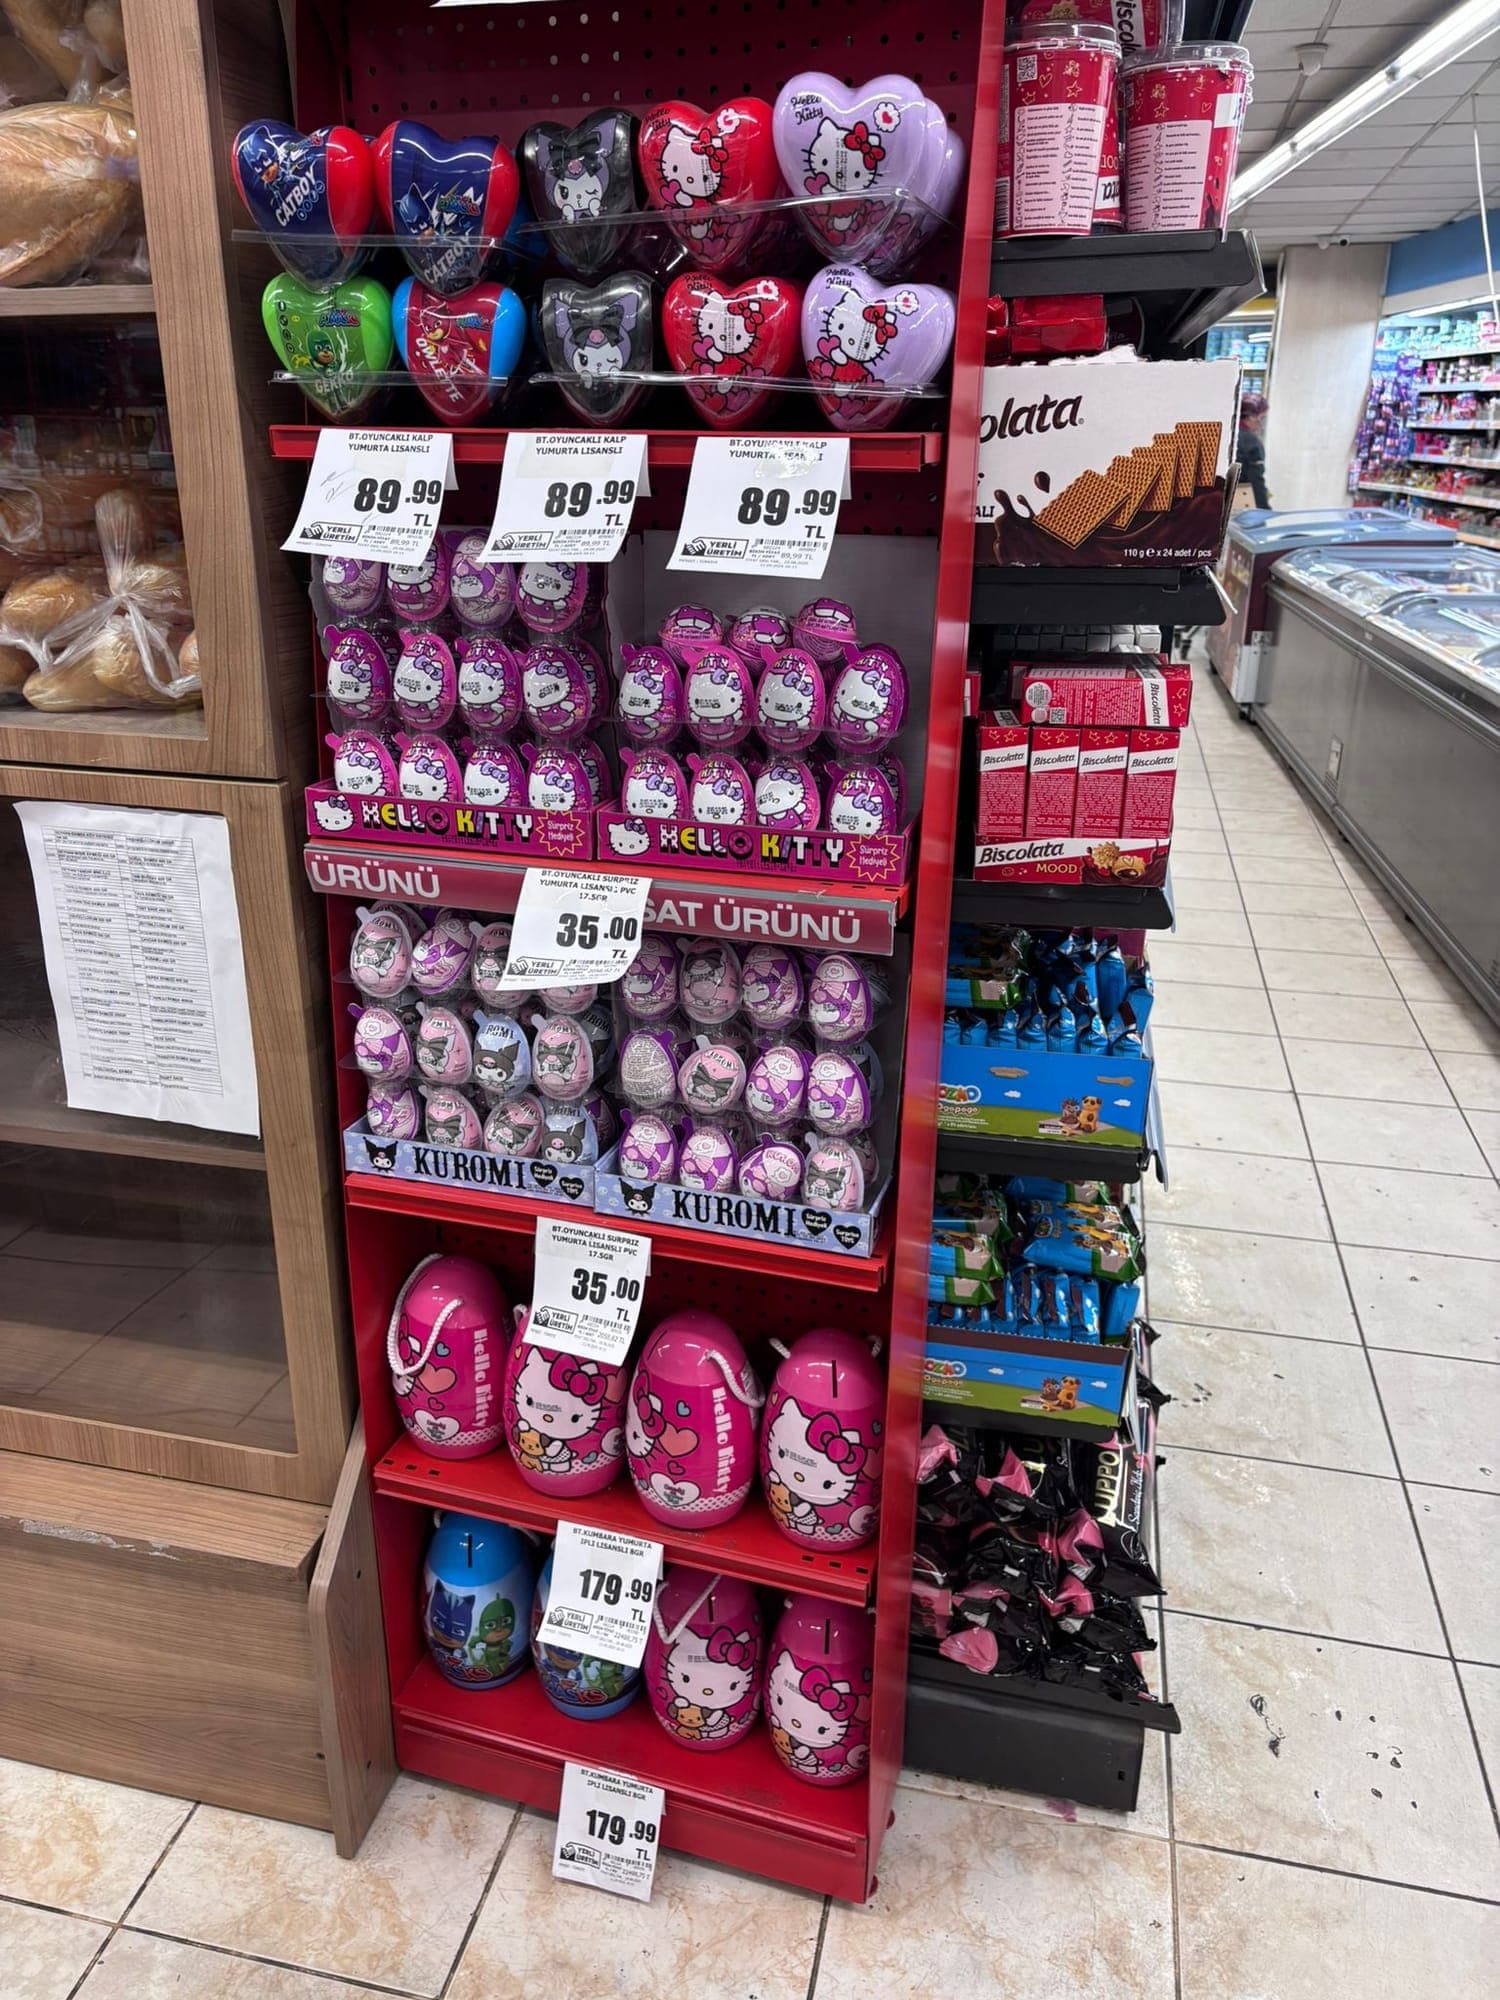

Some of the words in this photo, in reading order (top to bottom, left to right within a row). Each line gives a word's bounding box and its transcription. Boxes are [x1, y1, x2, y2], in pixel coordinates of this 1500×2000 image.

[1116, 0, 1142, 57] iscol
[795, 106, 824, 126] Kitty
[275, 159, 317, 227] CATBOY
[423, 226, 474, 284] CATBOY
[980, 394, 1083, 443] olata
[411, 434, 433, 442] KALP
[603, 436, 627, 444] KALP
[348, 443, 389, 453] YUMURTA
[535, 447, 579, 455] YUMURTA
[975, 506, 995, 518] ALI
[413, 513, 433, 527] TL
[604, 514, 624, 526] TL
[327, 525, 352, 535] YERLİ
[804, 525, 826, 539] TL
[323, 532, 356, 542] ÜRETİM
[514, 541, 547, 549] ÜRETİM
[709, 540, 737, 549] YERLİ
[706, 548, 742, 557] ÜRETİM
[1123, 549, 1138, 558] 110
[1162, 549, 1173, 557] 24
[1174, 548, 1191, 557] adet
[1197, 550, 1212, 560] pcs
[1150, 682, 1162, 725] Biscolata
[983, 752, 1025, 765] Biscolata
[1033, 754, 1075, 766] Biscolata
[1082, 753, 1124, 766] Biscolata
[1131, 755, 1174, 768] Biscolata
[361, 800, 449, 836] HELLO
[456, 809, 533, 842] KITTY
[659, 824, 754, 859] HELLO
[761, 832, 844, 866] KITTY
[979, 842, 1065, 864] Biscolata
[1035, 862, 1078, 874] MOOD
[311, 854, 441, 899] ÜRÜNÜ
[539, 879, 578, 889] YUMURTA
[620, 886, 637, 895] PVC
[643, 898, 704, 928] SAT
[713, 897, 861, 944] ÜRÜNÜ
[611, 949, 628, 959] TL
[531, 960, 555, 968] YERLİ
[528, 967, 557, 975] ÜRETİM
[413, 1146, 529, 1190] KUROMI
[672, 1189, 796, 1238] KUROMI
[551, 1234, 587, 1246] YUMURTA
[623, 1247, 638, 1256] PVC
[607, 1234, 640, 1246] SURPRIZ
[588, 1250, 614, 1261] 17.5GR
[551, 1311, 571, 1322] YERLİ
[616, 1307, 630, 1322] TL
[474, 1328, 491, 1382] Hello
[712, 1387, 733, 1444] Hello
[618, 1536, 653, 1549] YUMURTA
[566, 1612, 586, 1622] YERLİ
[631, 1608, 646, 1623] TL
[635, 1848, 651, 1861] TL
